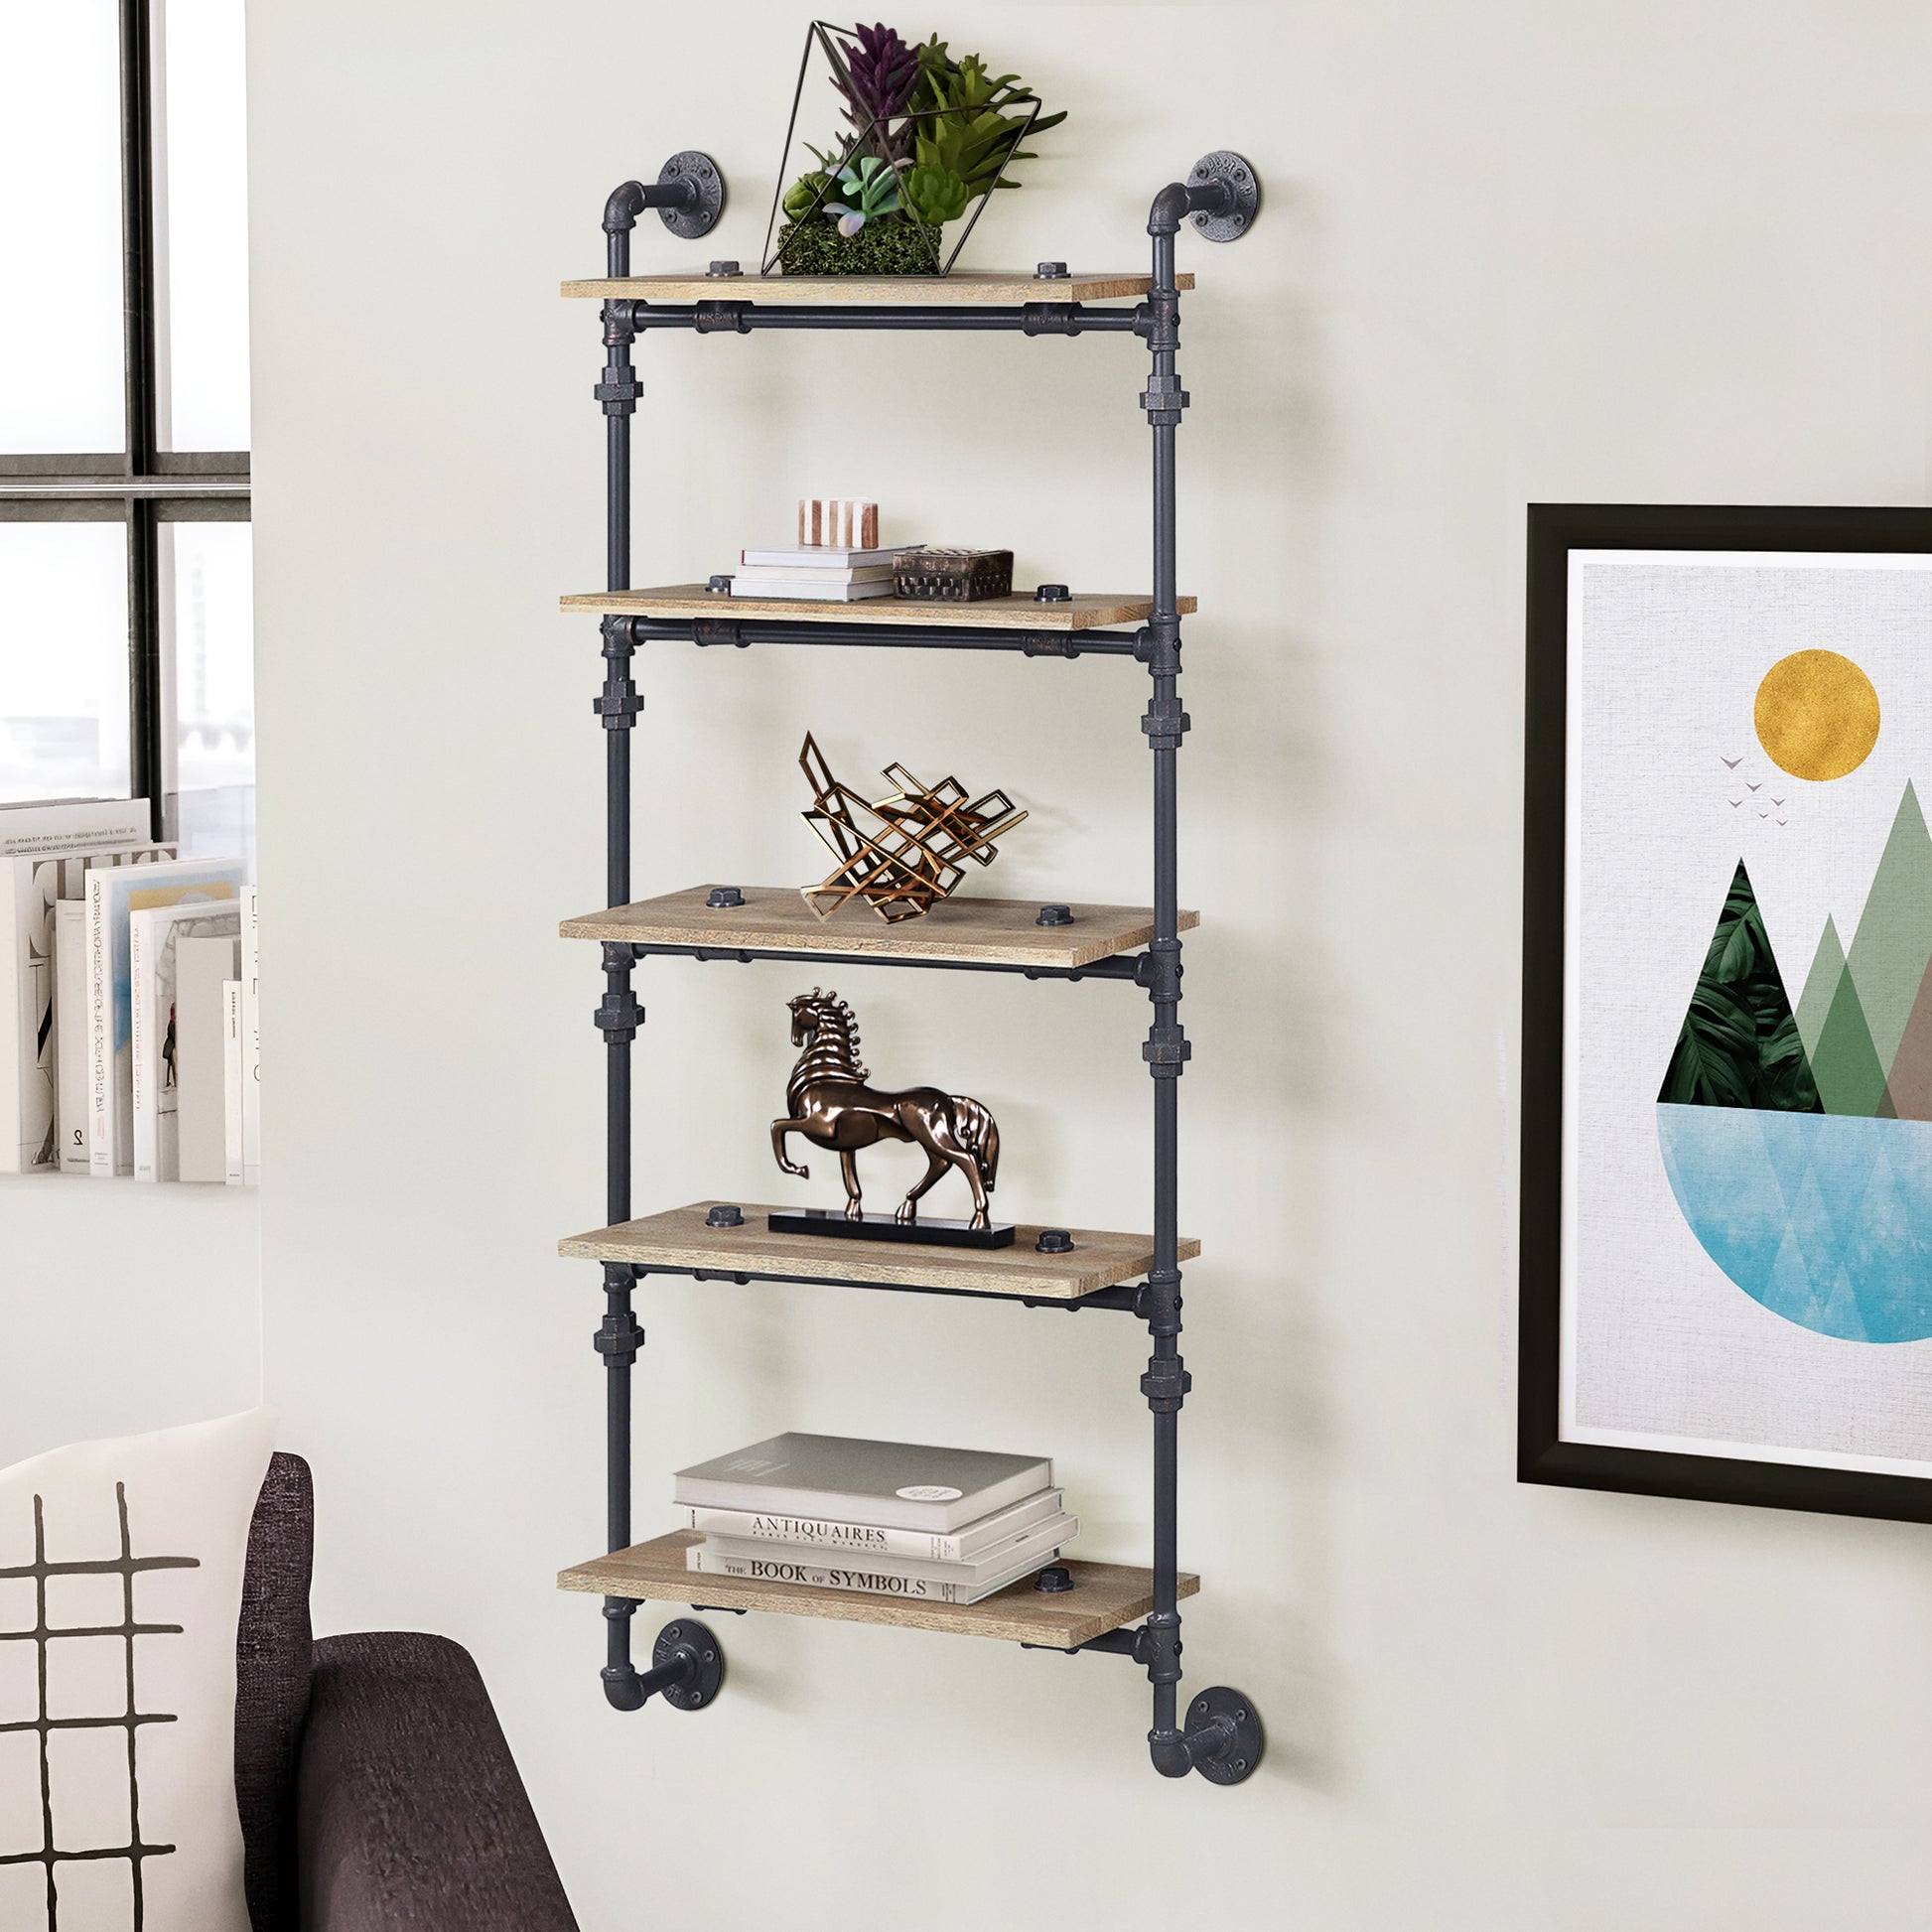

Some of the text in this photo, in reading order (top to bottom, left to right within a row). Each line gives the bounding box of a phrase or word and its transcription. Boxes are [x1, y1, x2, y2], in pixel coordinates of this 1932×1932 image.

[752, 1516, 887, 1544] ANTIQUAIRES
[725, 1563, 747, 1575] THE
[751, 1560, 808, 1583] BOOK
[811, 1575, 826, 1584] OF
[829, 1570, 926, 1595] SYMBOLS
